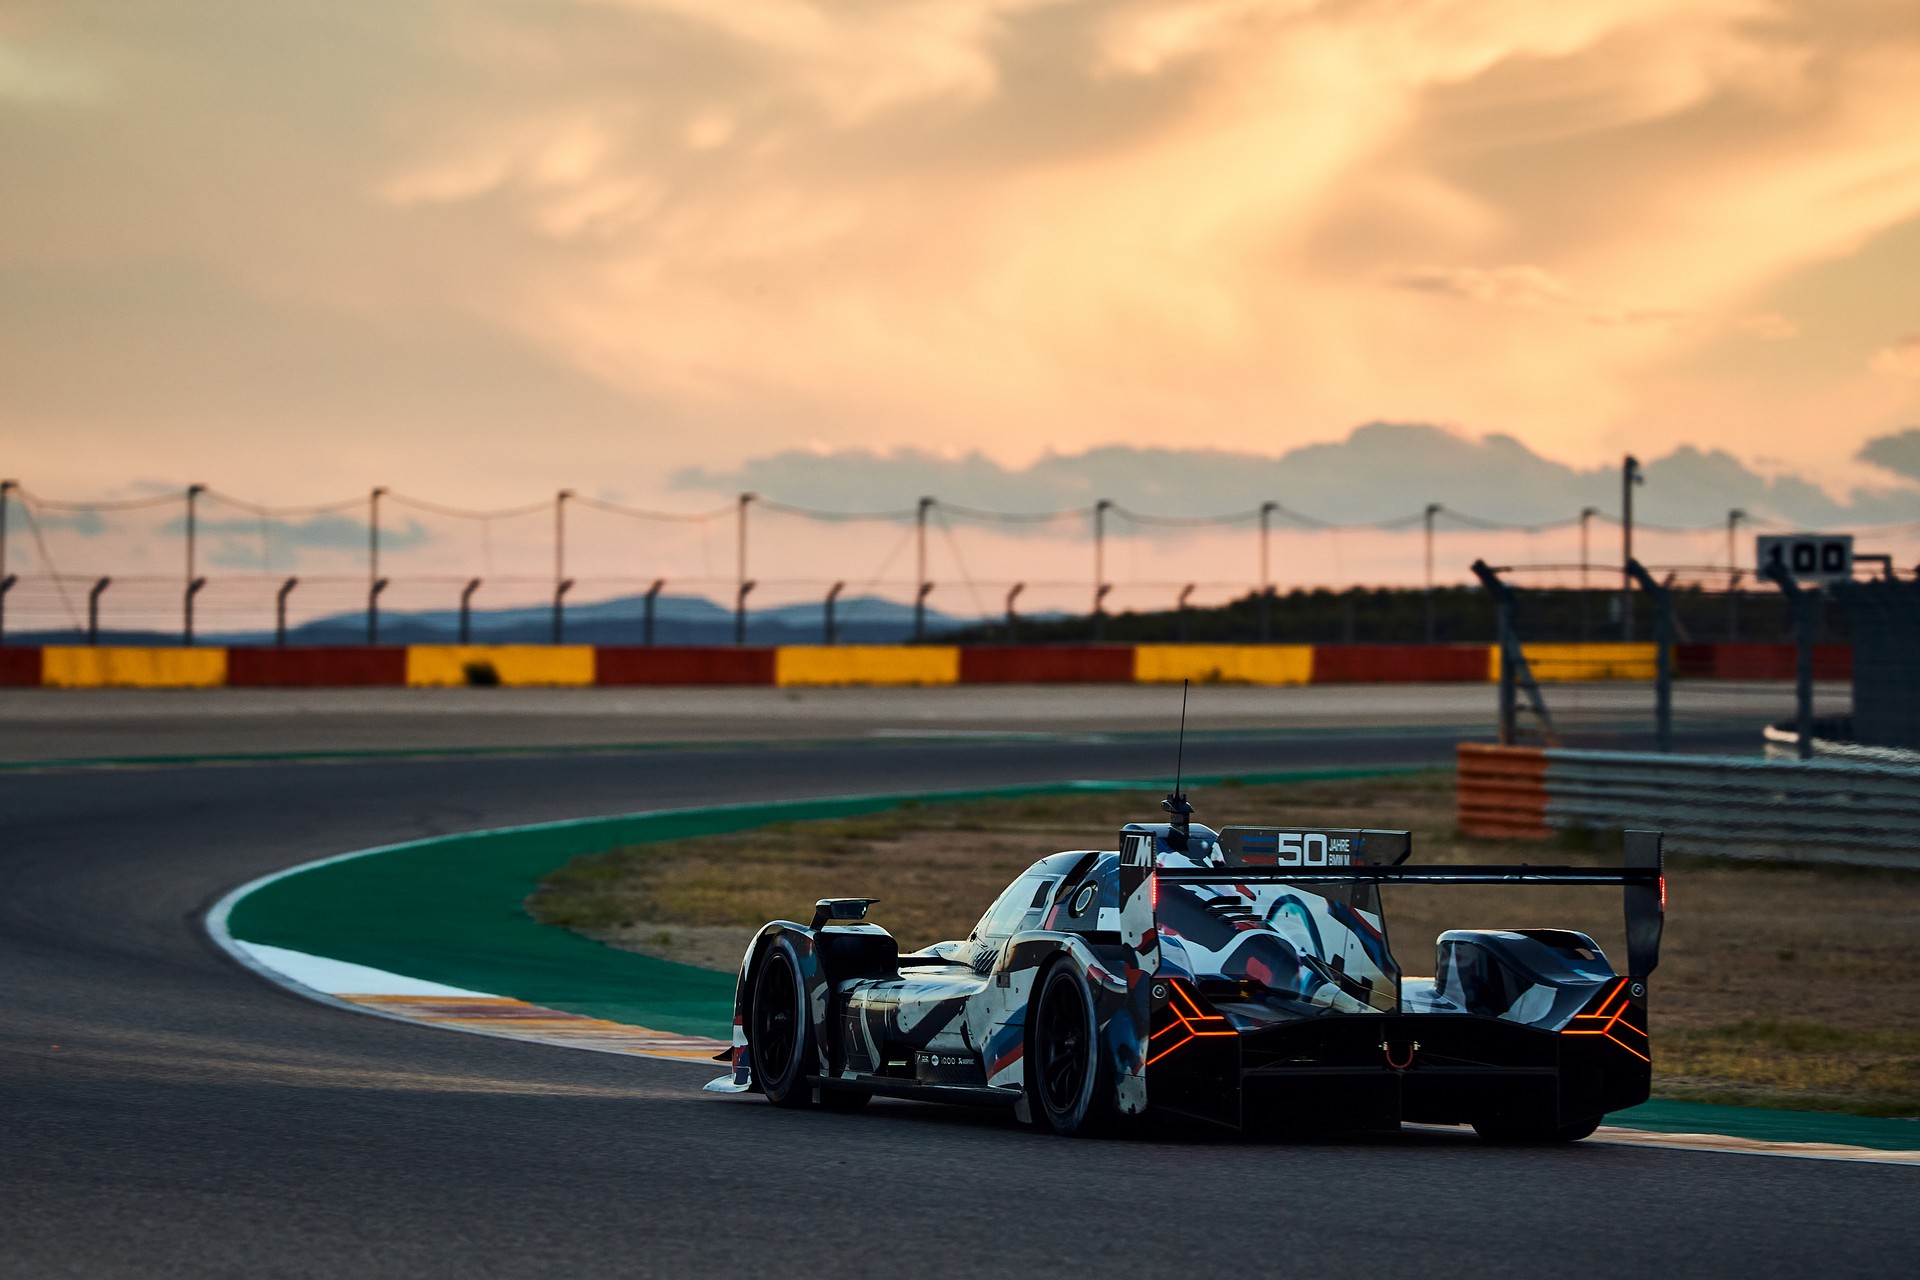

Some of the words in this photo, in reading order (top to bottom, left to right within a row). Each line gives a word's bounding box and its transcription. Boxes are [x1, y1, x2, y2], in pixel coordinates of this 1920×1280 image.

[1769, 543, 1845, 573] 100
[1278, 833, 1327, 866] 50
[1328, 838, 1350, 852] JAHRE
